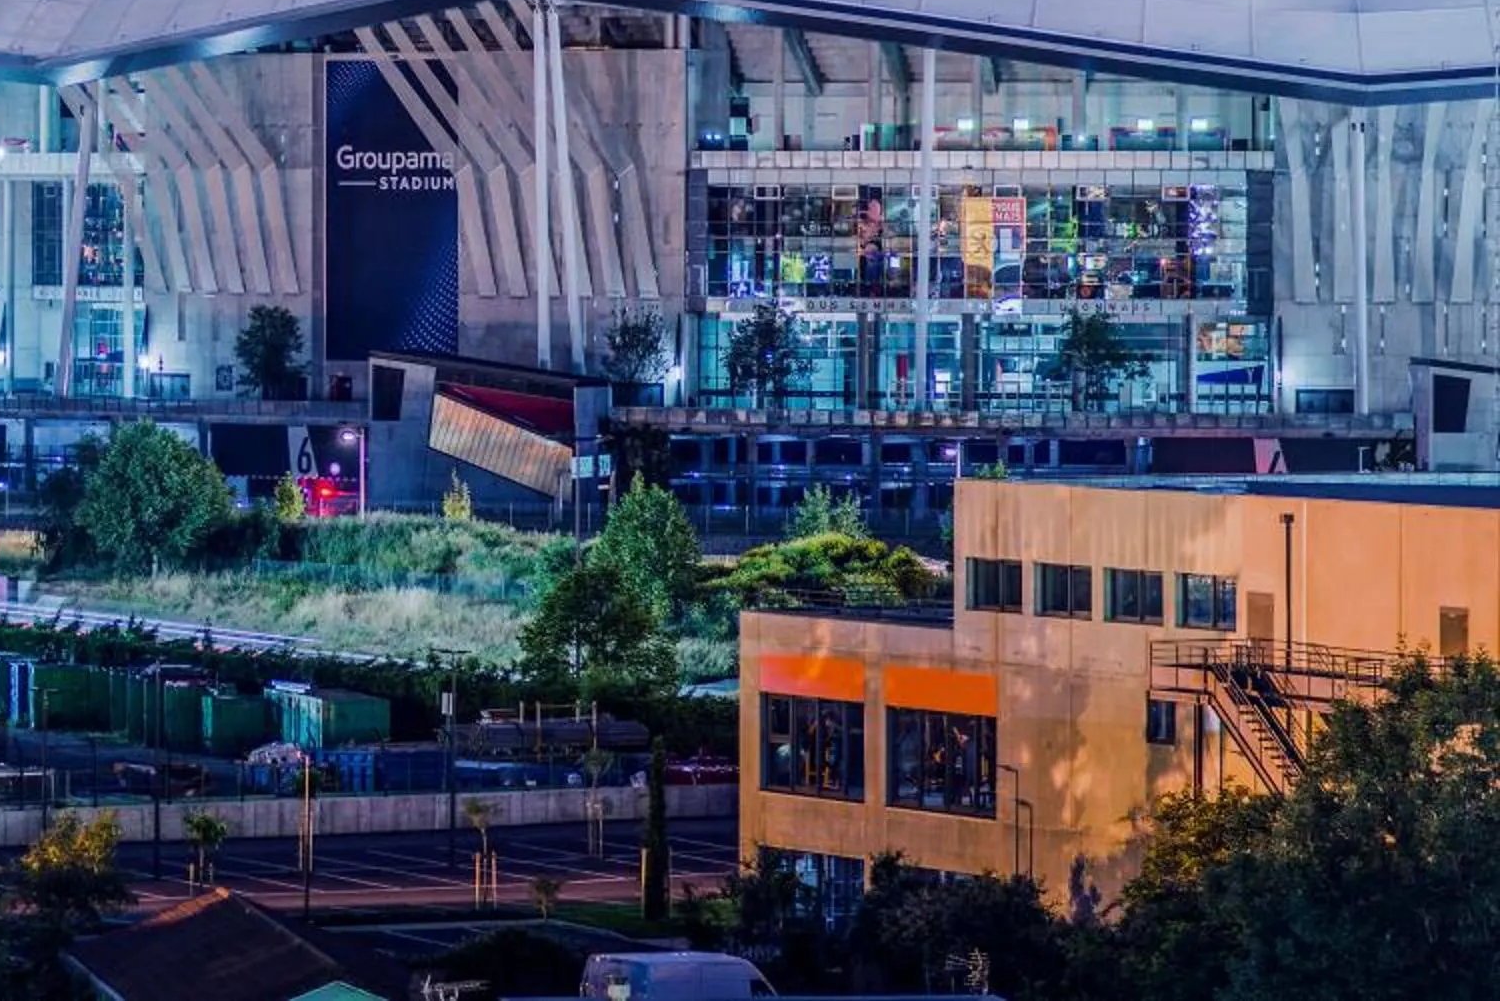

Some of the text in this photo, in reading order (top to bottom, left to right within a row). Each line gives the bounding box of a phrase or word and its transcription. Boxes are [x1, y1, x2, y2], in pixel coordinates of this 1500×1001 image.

[336, 145, 454, 174] Groupama
[379, 176, 455, 190] STADIUM
[298, 436, 312, 474] 6
